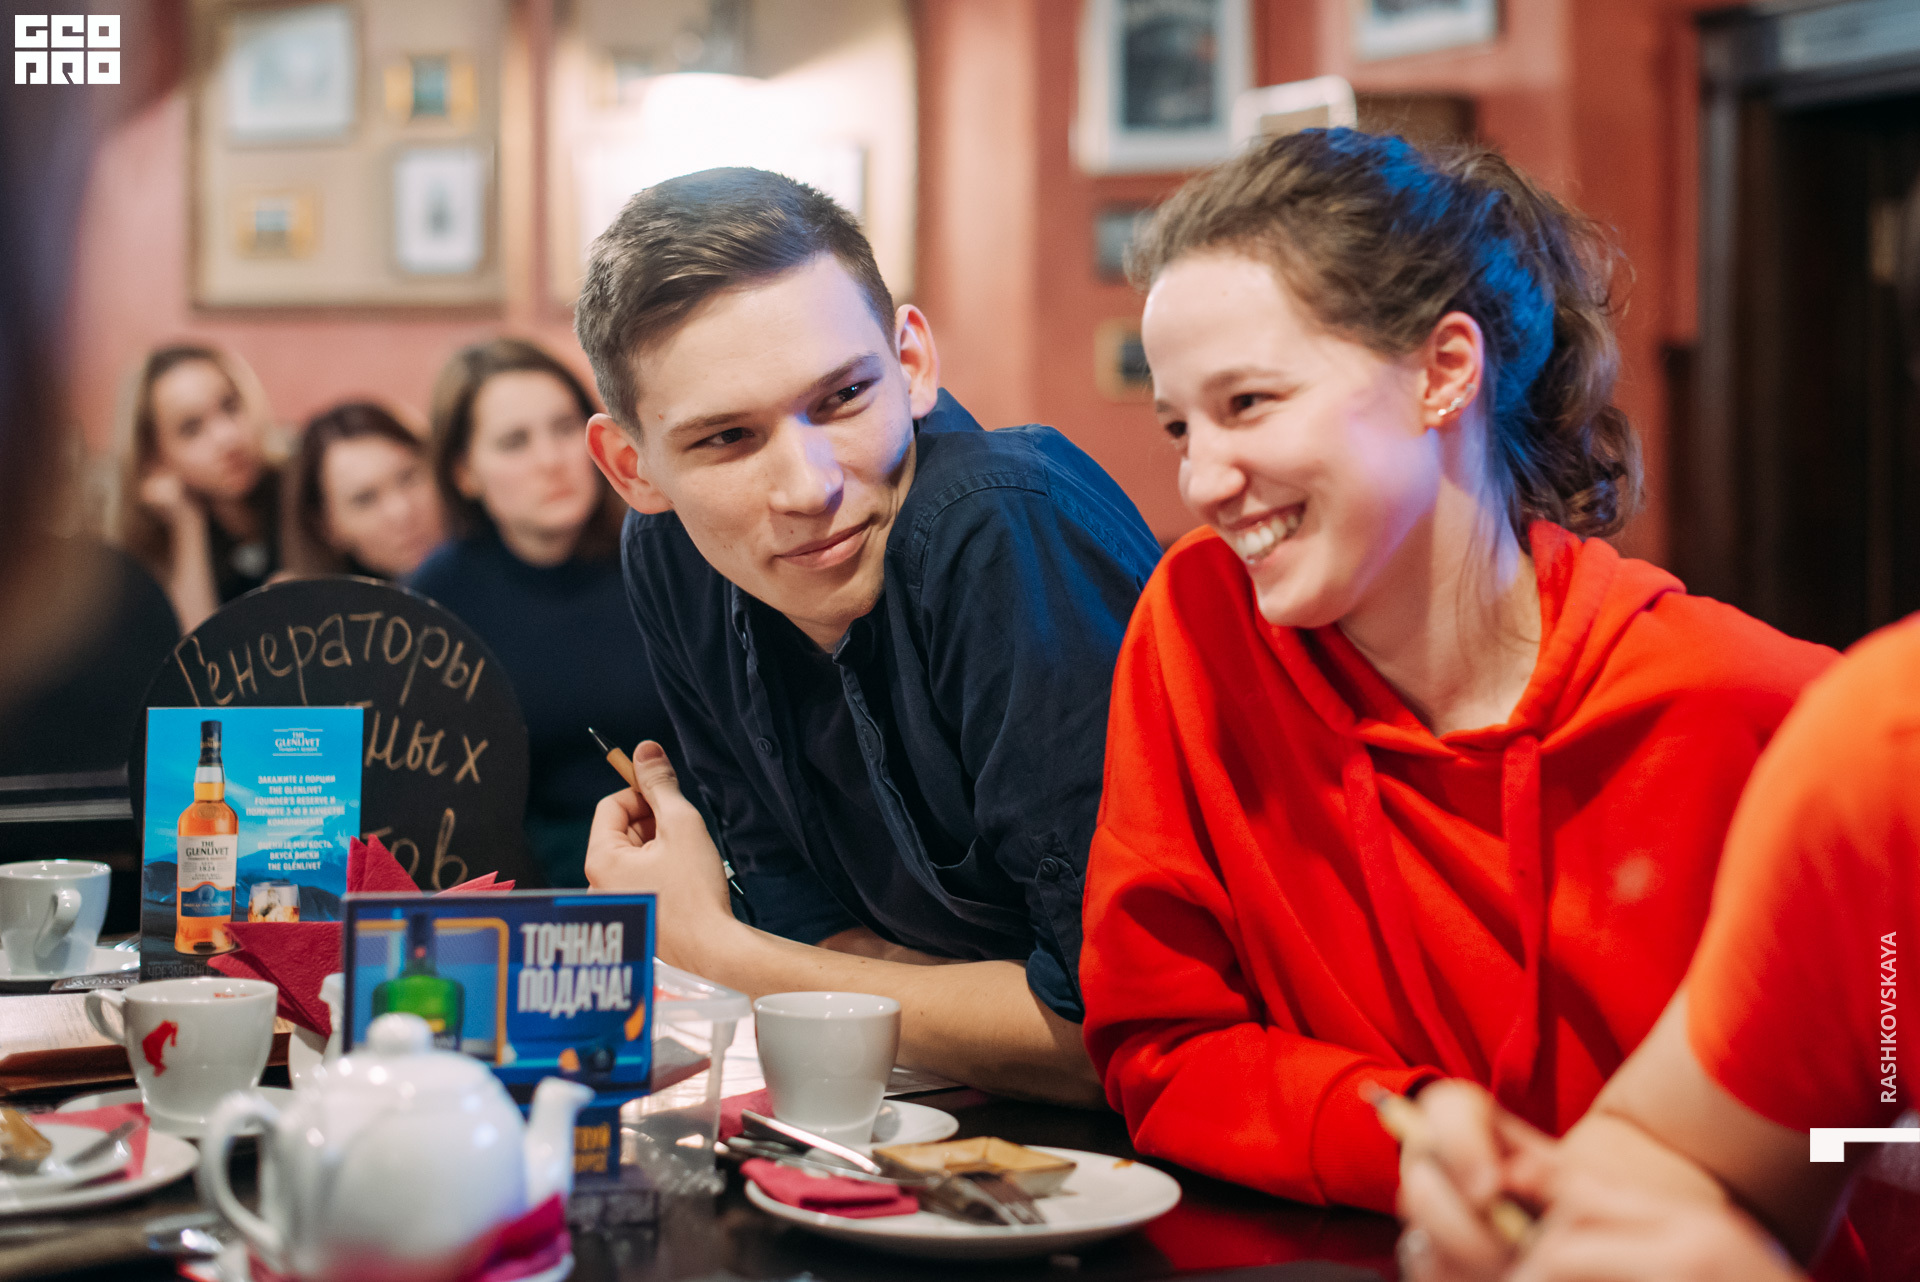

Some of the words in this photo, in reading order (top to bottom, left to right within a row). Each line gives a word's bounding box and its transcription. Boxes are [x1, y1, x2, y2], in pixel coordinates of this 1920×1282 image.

[174, 611, 486, 706] Генераторы
[275, 738, 320, 748] GLENLIVET
[258, 775, 297, 784] ЗАКАЖИТЕ
[305, 774, 336, 784] ПОРЦИИ
[269, 786, 282, 795] THE
[284, 785, 322, 795] GLENLIVET
[254, 796, 295, 806] FOUNDER'S
[296, 796, 328, 805] RESERVE
[185, 847, 229, 856] GLENLIVET
[269, 852, 293, 860] ВКУСА
[268, 863, 281, 871] THE
[283, 861, 321, 871] GLENLIVET
[521, 921, 624, 966] ТОЧНАЯ
[517, 965, 633, 1019] ПОДАЧА!
